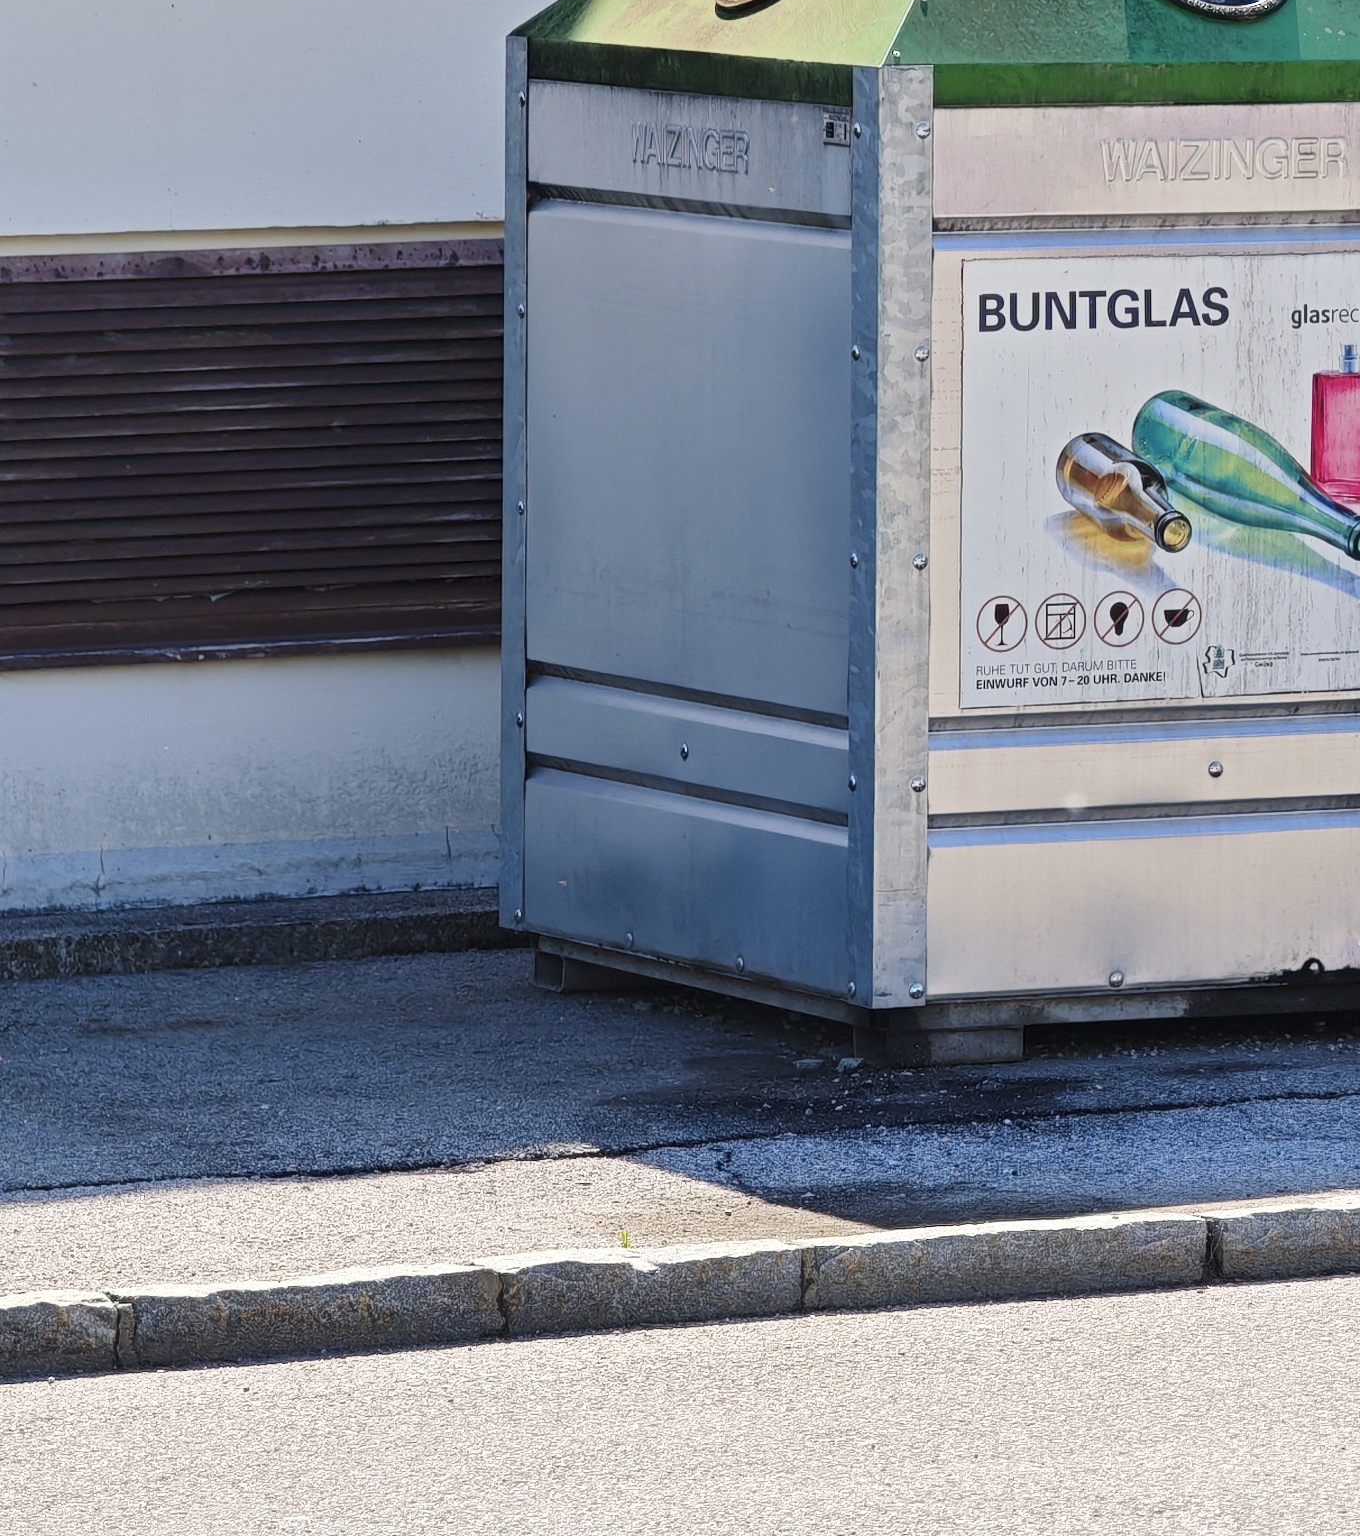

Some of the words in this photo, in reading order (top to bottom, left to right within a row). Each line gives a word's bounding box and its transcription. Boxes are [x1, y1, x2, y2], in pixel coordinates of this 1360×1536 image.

[630, 120, 749, 175] WAIZINGER
[1100, 136, 1350, 183] WAIZINGER
[978, 286, 1230, 333] BUNTGLAS
[976, 664, 1006, 677] RUHE
[1009, 663, 1031, 675] TUT
[1061, 661, 1104, 673] DARUM
[1106, 659, 1137, 671] BITTE
[976, 677, 1030, 690] EINWURF
[1032, 675, 1058, 688] VON
[1092, 673, 1121, 685] UHR.
[1123, 671, 1167, 684] DANKE!
